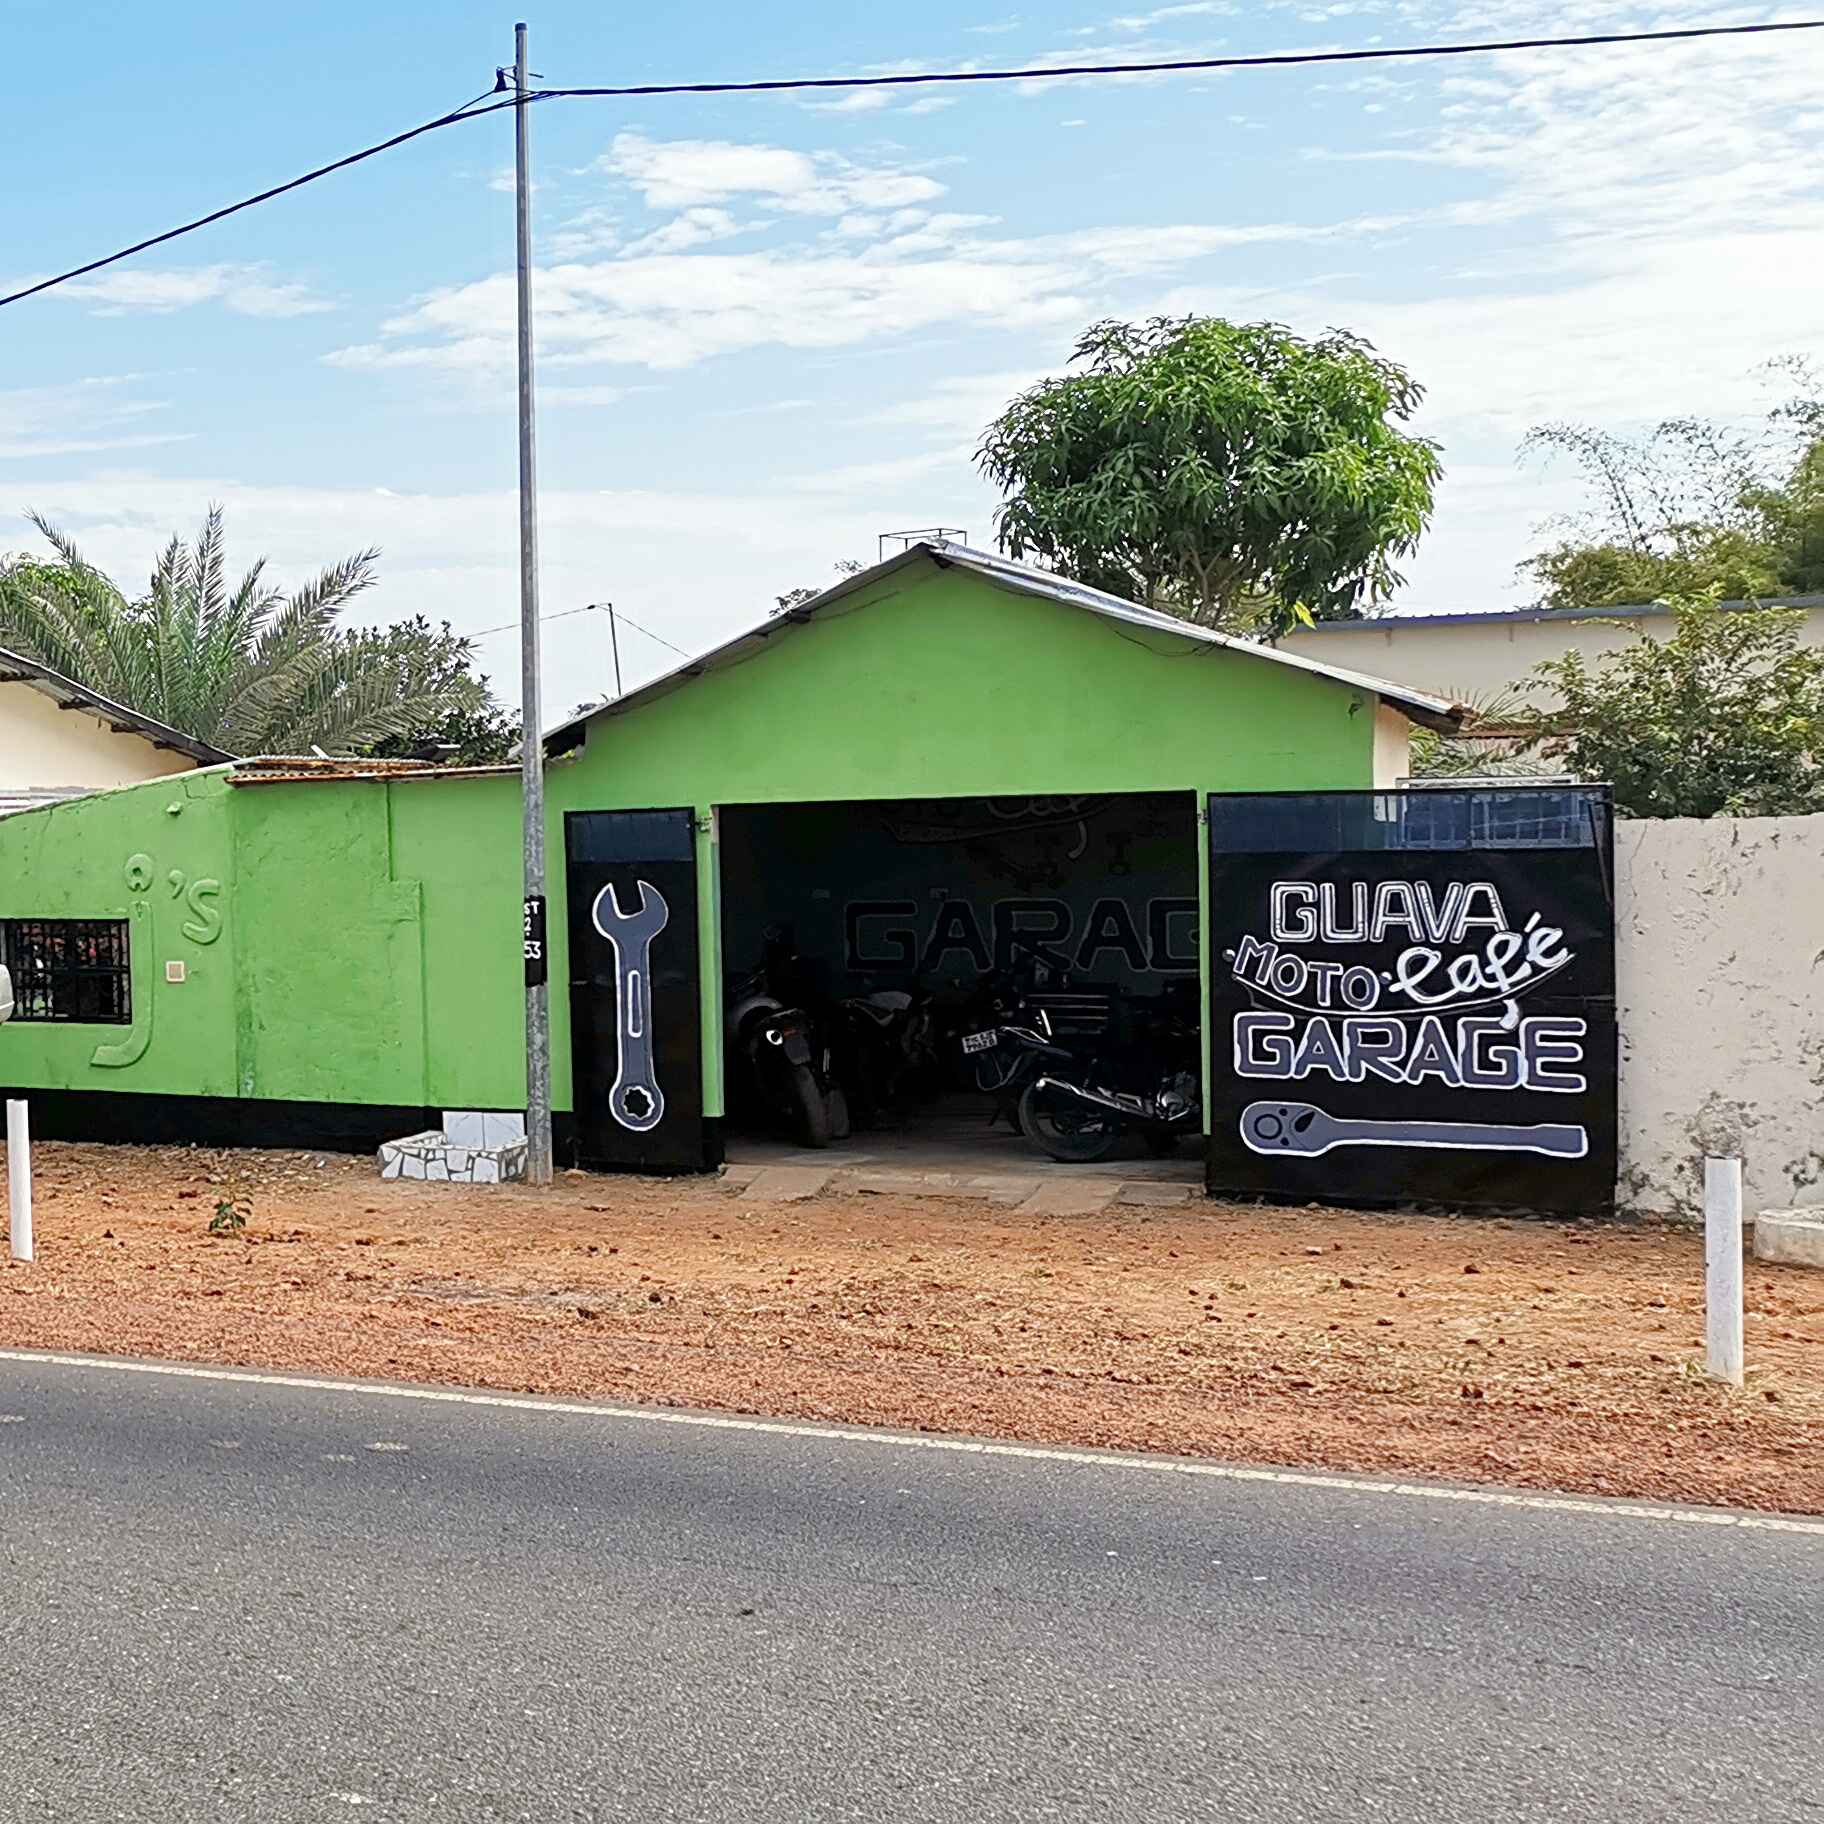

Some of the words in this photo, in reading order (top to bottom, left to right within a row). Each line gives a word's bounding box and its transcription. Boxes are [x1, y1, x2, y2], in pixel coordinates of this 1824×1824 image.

[1270, 881, 1510, 943] GUAVA
[523, 940, 541, 959] 53
[1233, 935, 1380, 1010] MOTO
[1234, 1011, 1587, 1093] GARAGE
